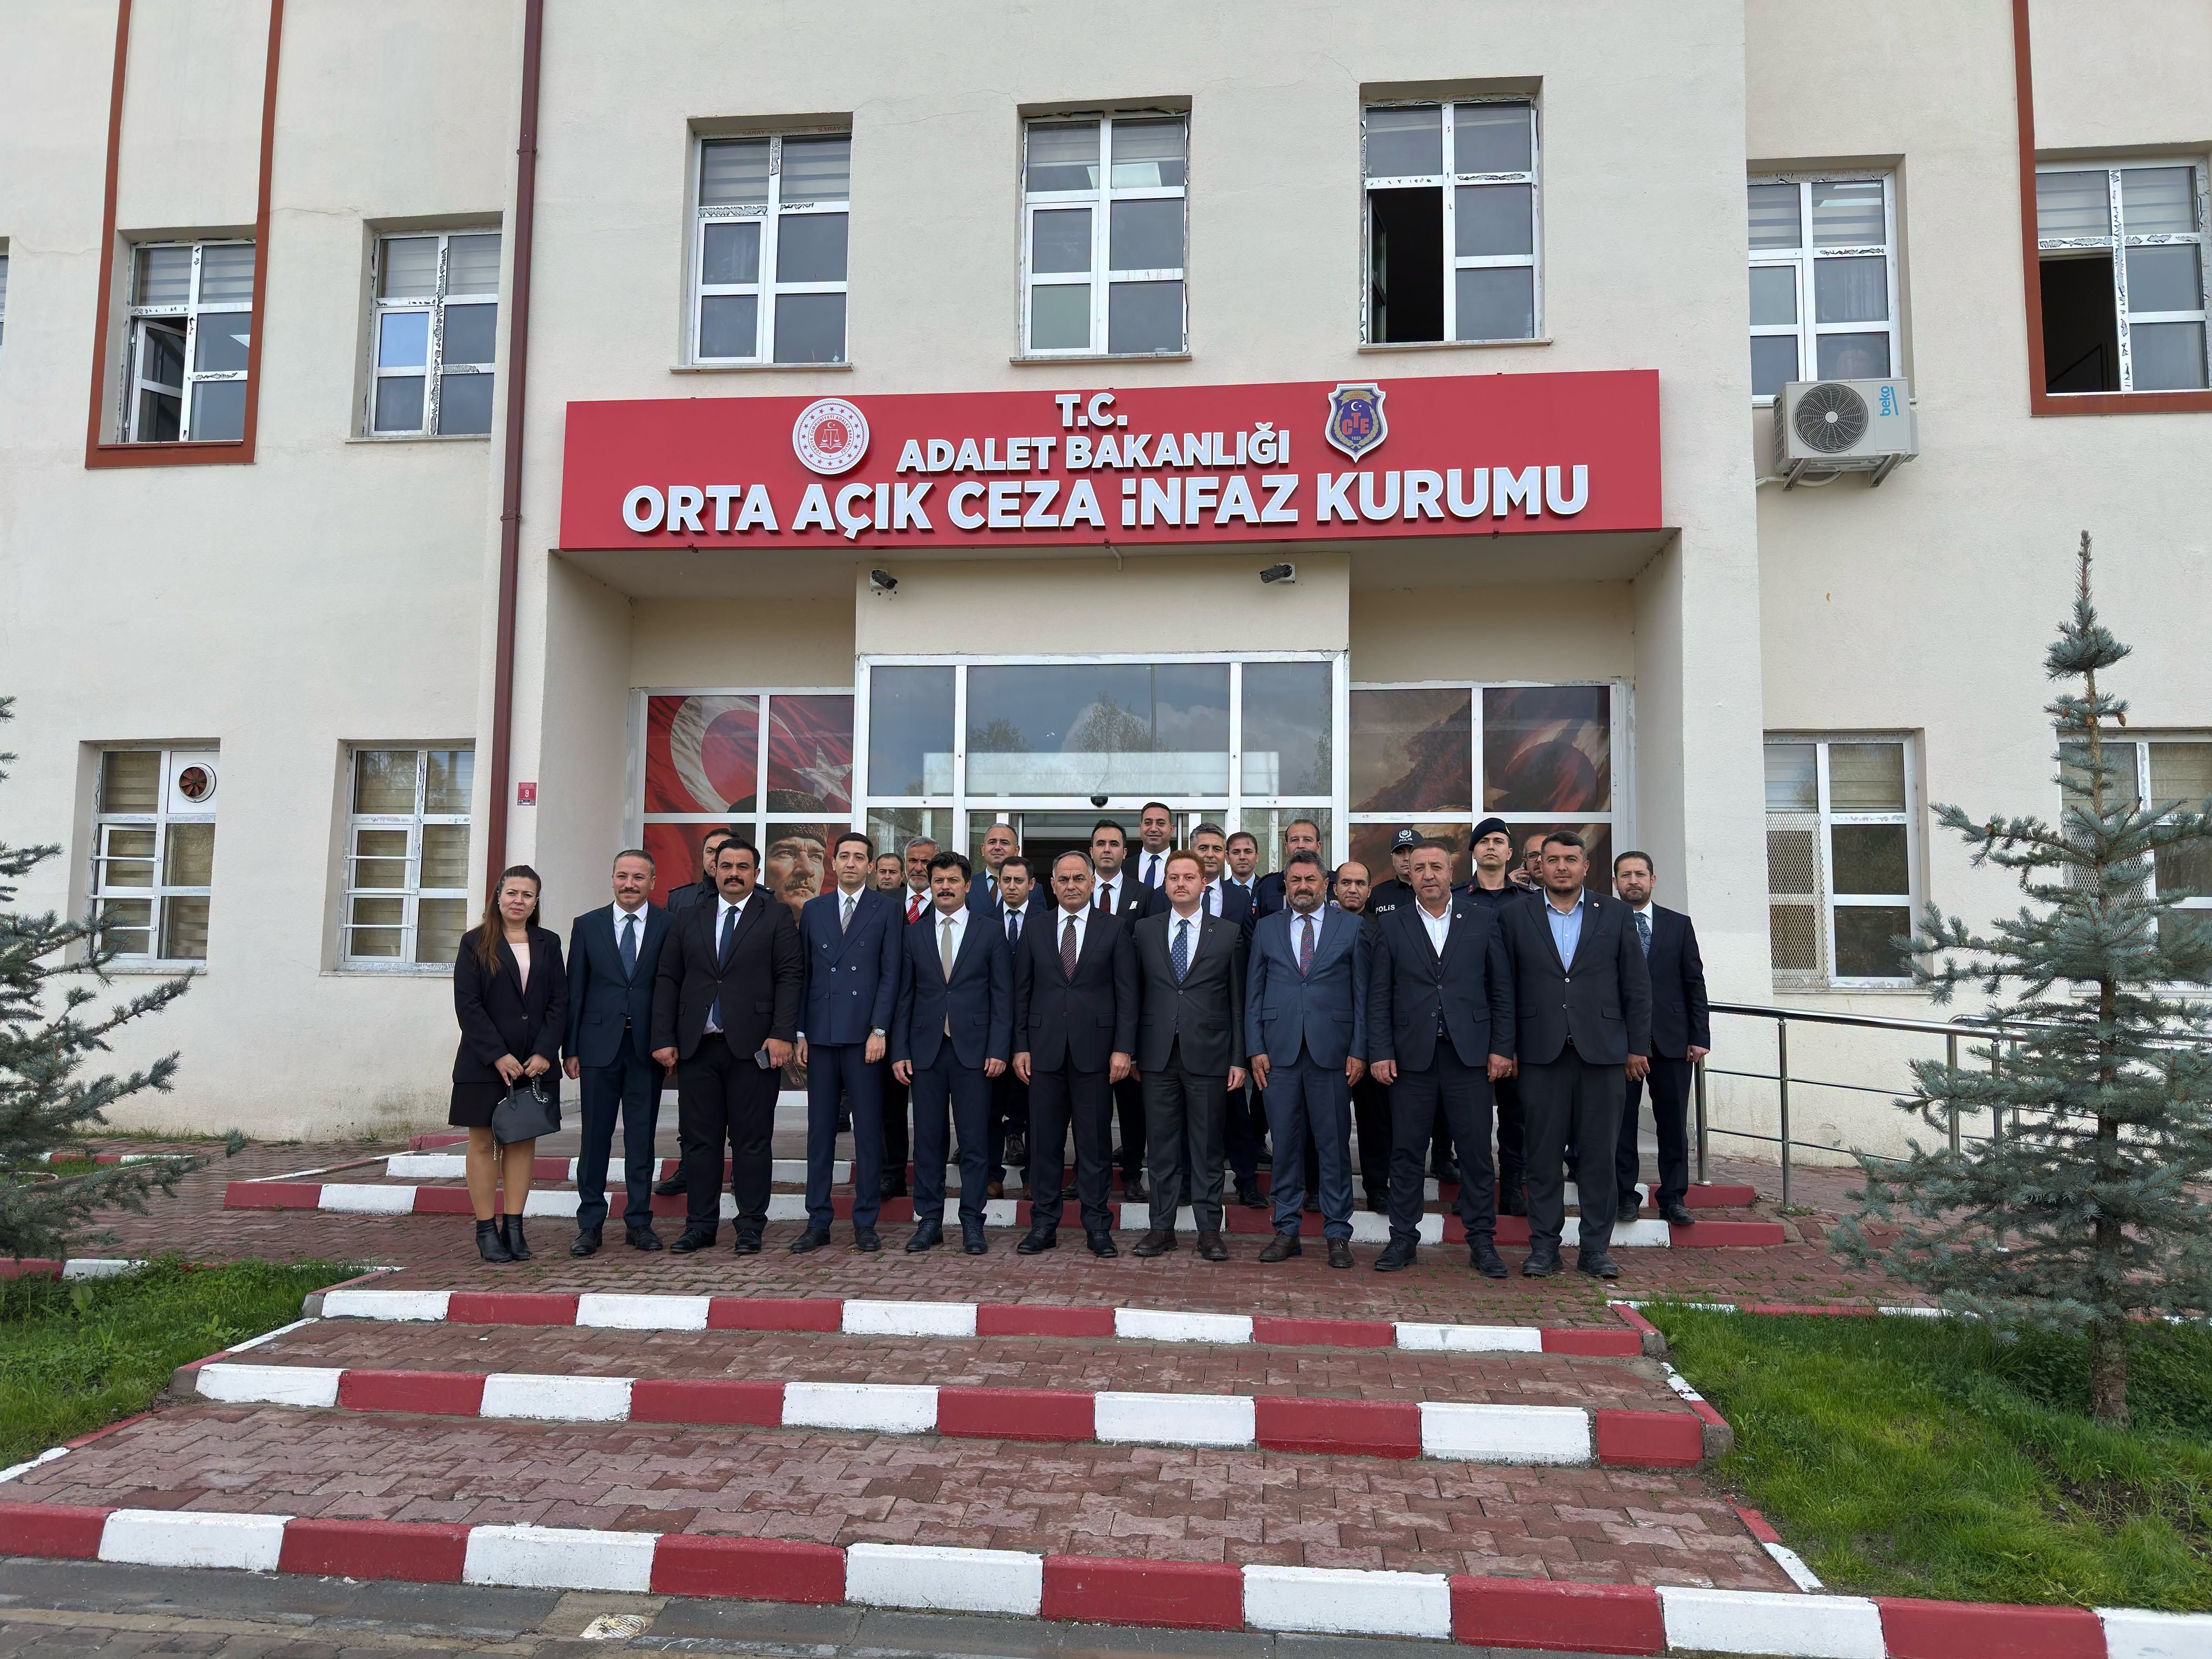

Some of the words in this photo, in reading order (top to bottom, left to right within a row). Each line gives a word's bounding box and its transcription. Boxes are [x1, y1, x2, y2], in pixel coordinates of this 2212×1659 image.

[1055, 392, 1128, 427] T.C.
[1879, 385, 1890, 417] beko
[835, 416, 851, 429] ADALET
[1342, 412, 1370, 435] CTE
[895, 436, 1056, 472] ADALET
[1065, 422, 1290, 469] BAKANLIĞI
[622, 484, 779, 532] ORTA
[791, 482, 934, 539] AÇIK
[947, 479, 1105, 529] CEZA
[1317, 464, 1588, 521] KURUMU
[525, 790, 529, 798] 9
